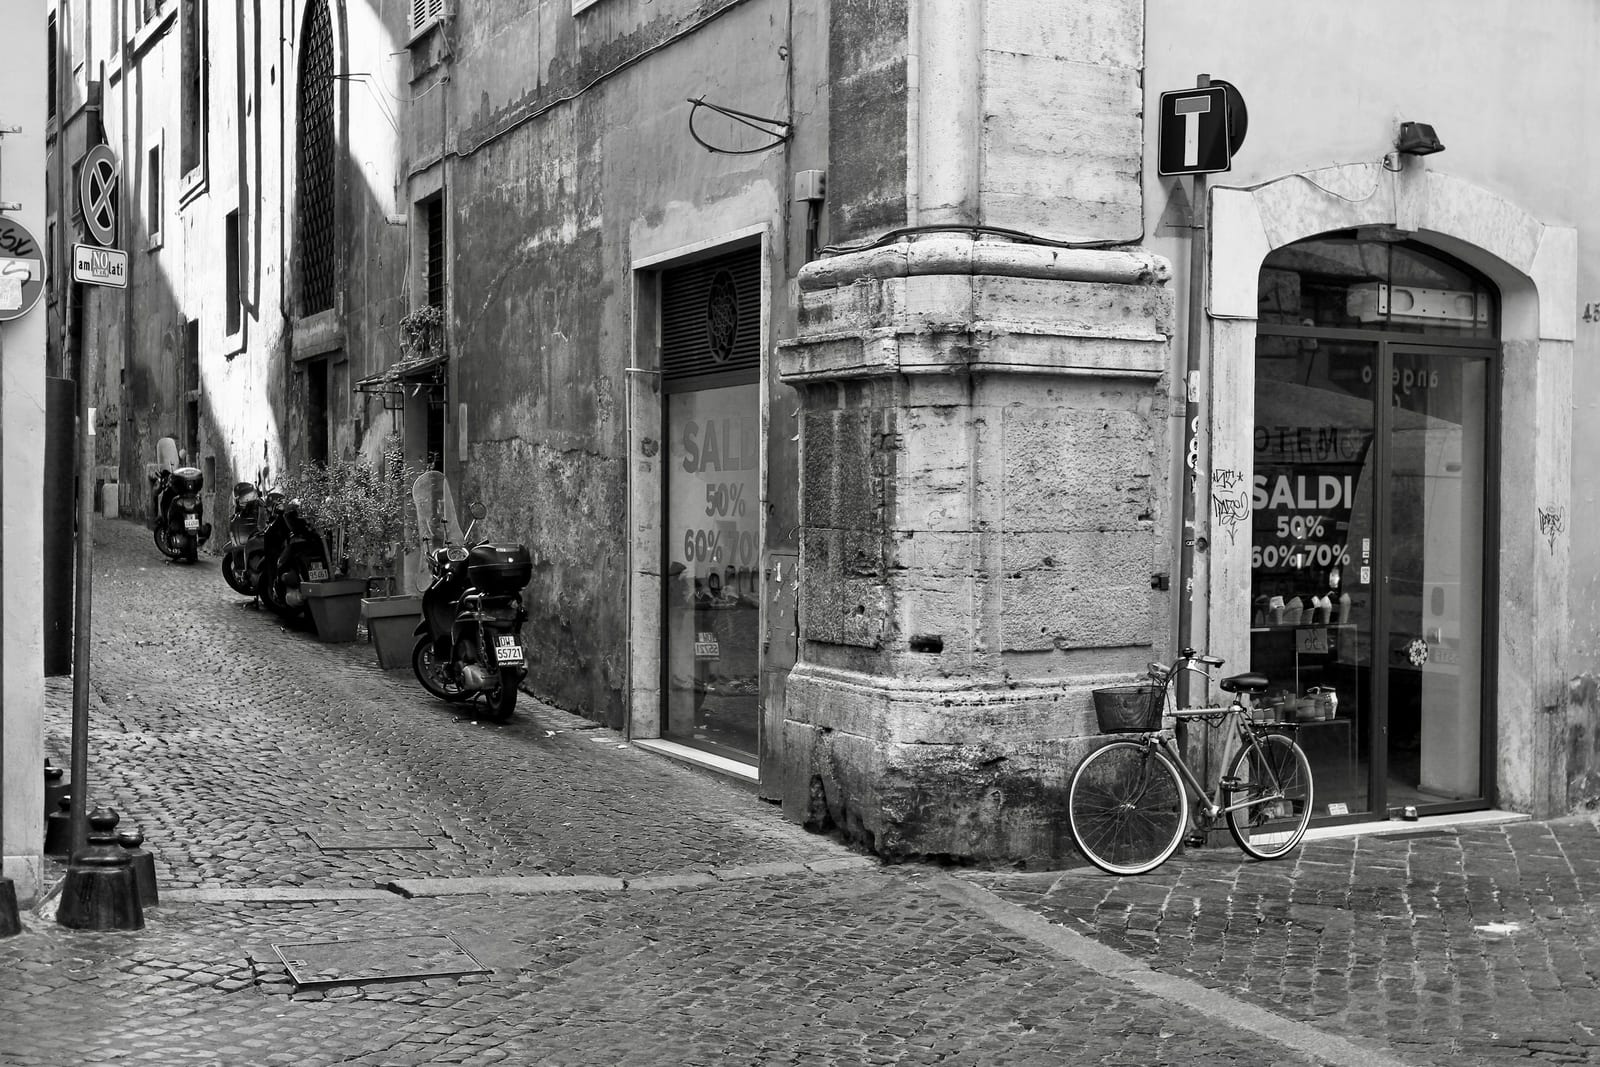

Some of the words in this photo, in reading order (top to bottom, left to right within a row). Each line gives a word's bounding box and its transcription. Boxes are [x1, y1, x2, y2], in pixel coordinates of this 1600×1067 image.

[78, 260, 91, 271] am
[108, 260, 124, 276] lati
[705, 483, 746, 517] 50%
[1252, 474, 1352, 510] SALDI
[1276, 515, 1325, 539] 50%
[684, 528, 723, 564] 60%
[1304, 543, 1350, 567] 70%
[497, 648, 522, 660] 55721
